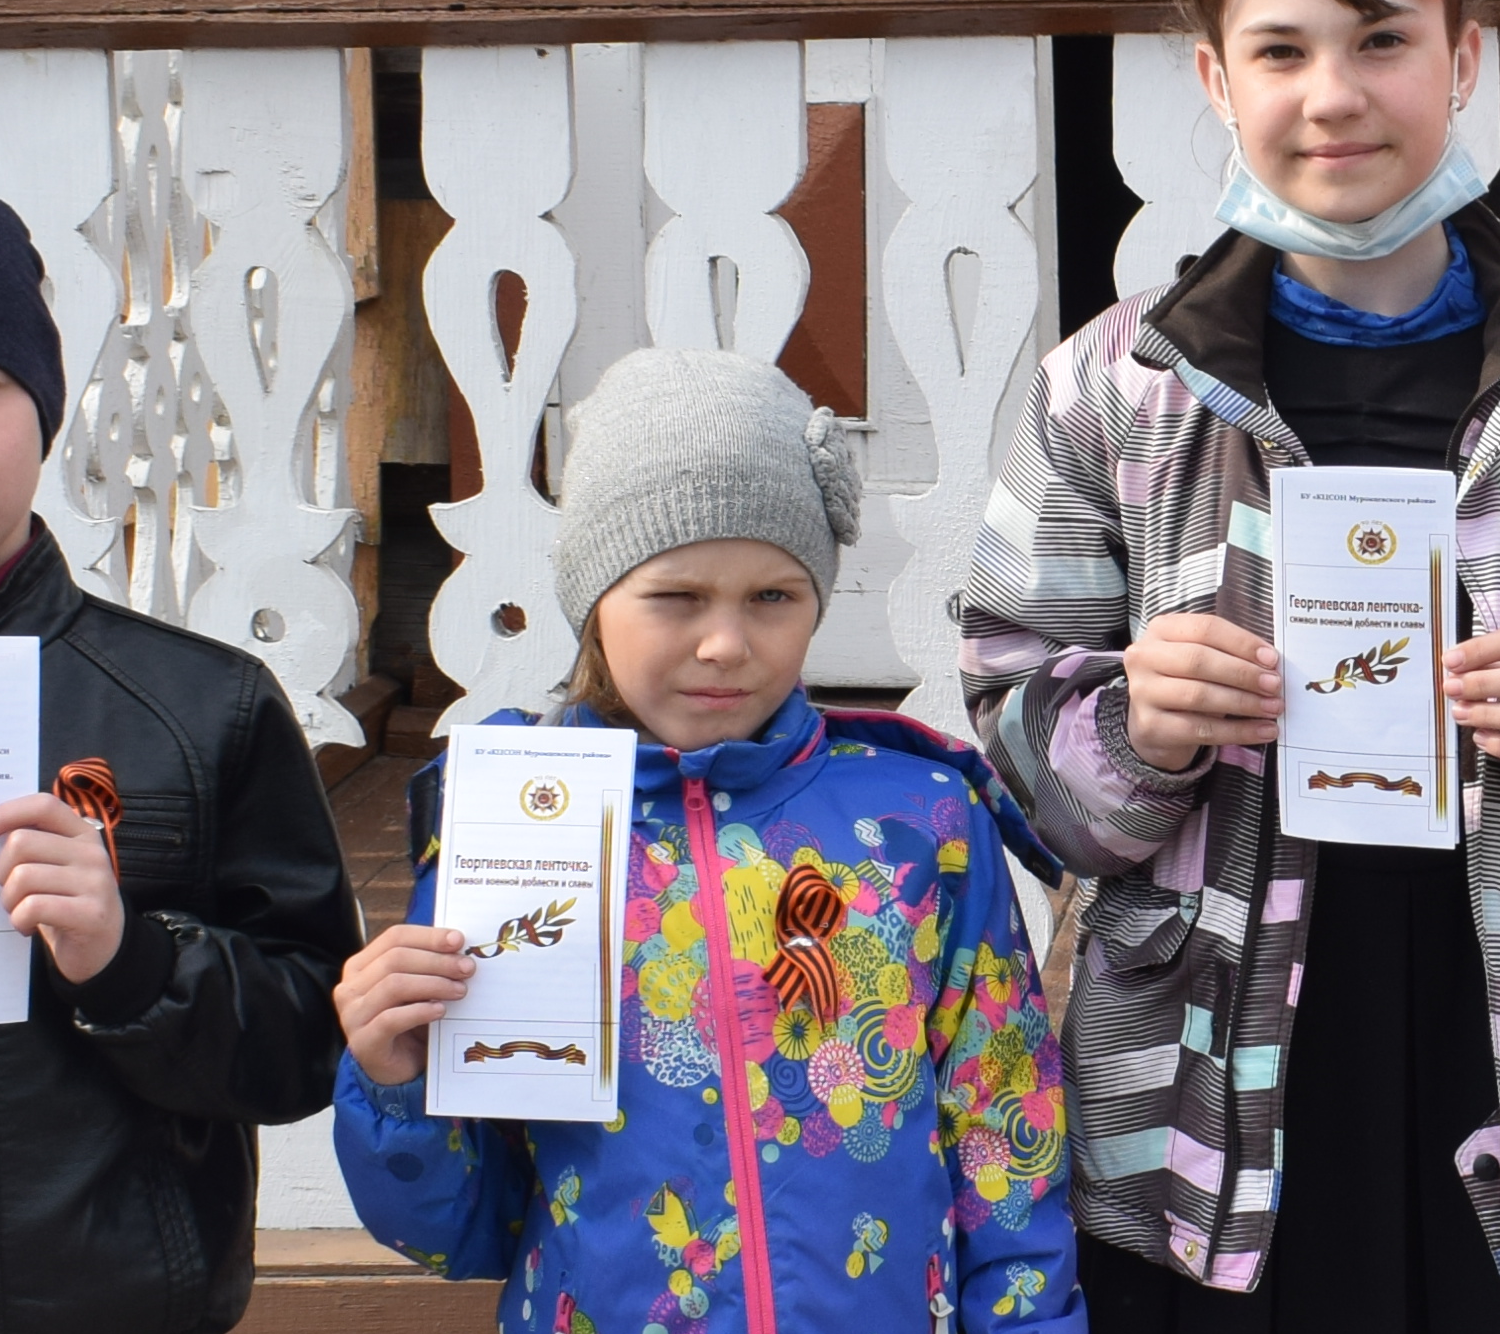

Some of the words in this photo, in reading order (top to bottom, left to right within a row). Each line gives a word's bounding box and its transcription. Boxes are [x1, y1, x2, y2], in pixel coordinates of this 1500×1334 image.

[1289, 595, 1364, 612] Георгиевская
[1366, 601, 1424, 613] ленточка-
[455, 854, 532, 872] Георгиевская
